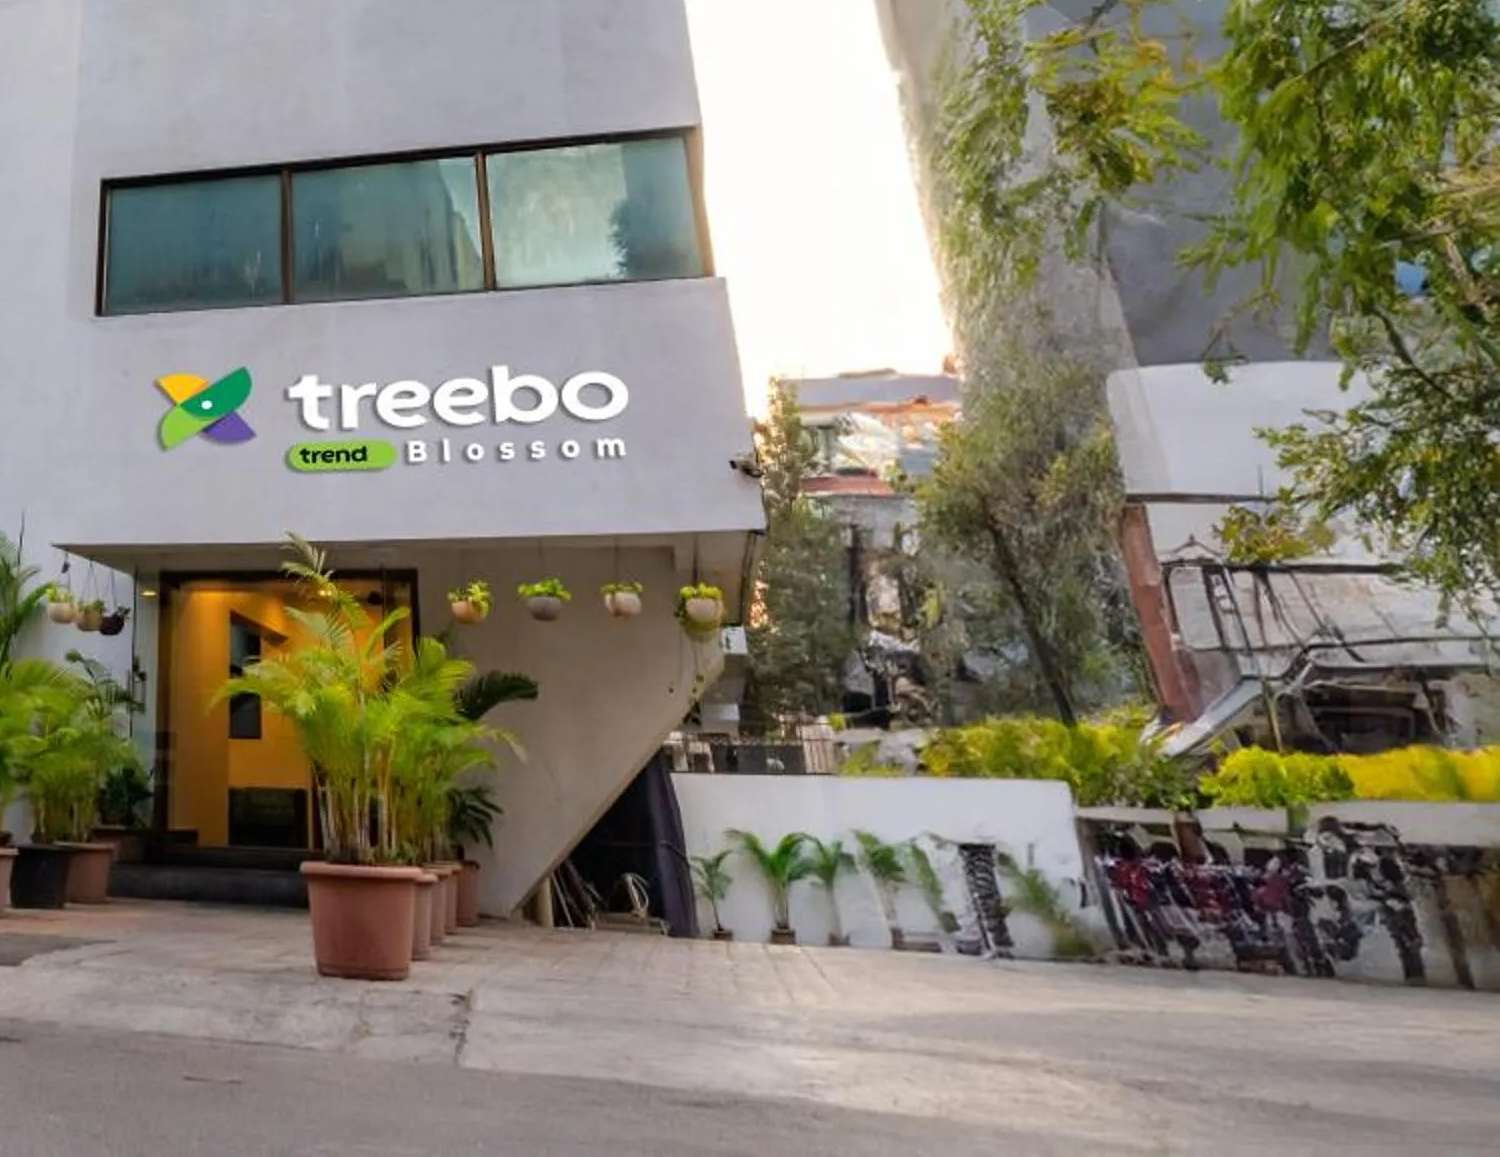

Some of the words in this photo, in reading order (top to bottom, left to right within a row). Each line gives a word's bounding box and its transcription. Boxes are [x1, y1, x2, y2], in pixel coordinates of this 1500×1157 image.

[287, 364, 630, 431] treebo
[298, 445, 368, 464] trend
[407, 437, 627, 463] Blossom
